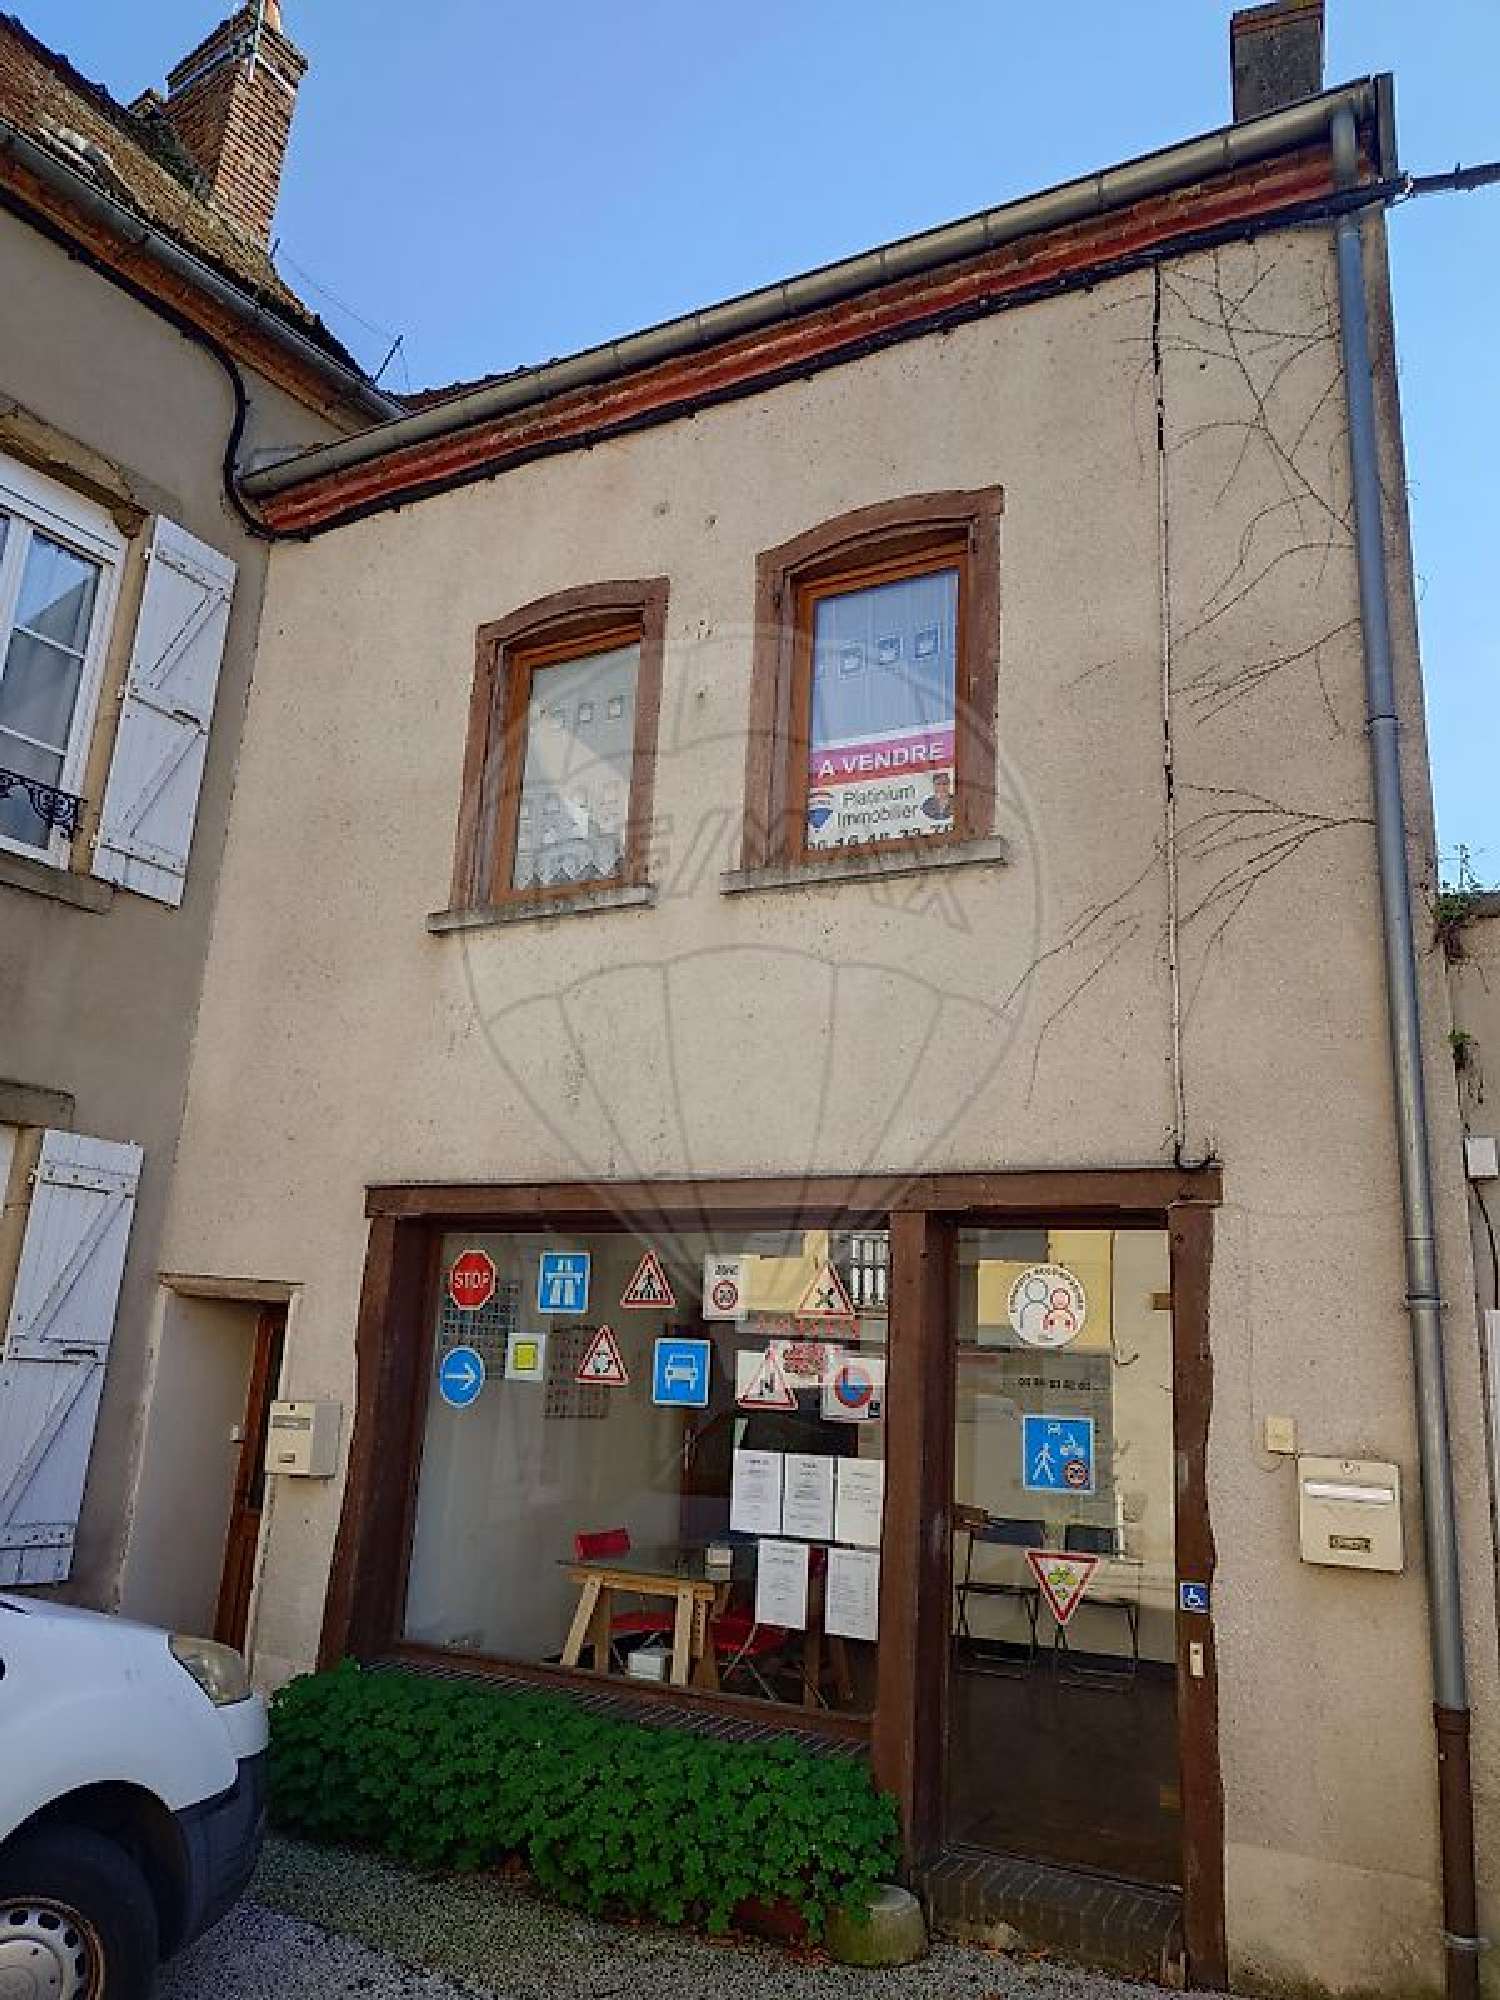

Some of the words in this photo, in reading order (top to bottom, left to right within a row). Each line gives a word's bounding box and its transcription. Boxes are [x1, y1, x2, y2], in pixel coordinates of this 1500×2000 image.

[818, 759, 835, 779] A
[843, 742, 944, 774] VENDRE
[842, 784, 916, 808] Platinium
[837, 804, 919, 829] Immobilier
[454, 1272, 489, 1289] STOP
